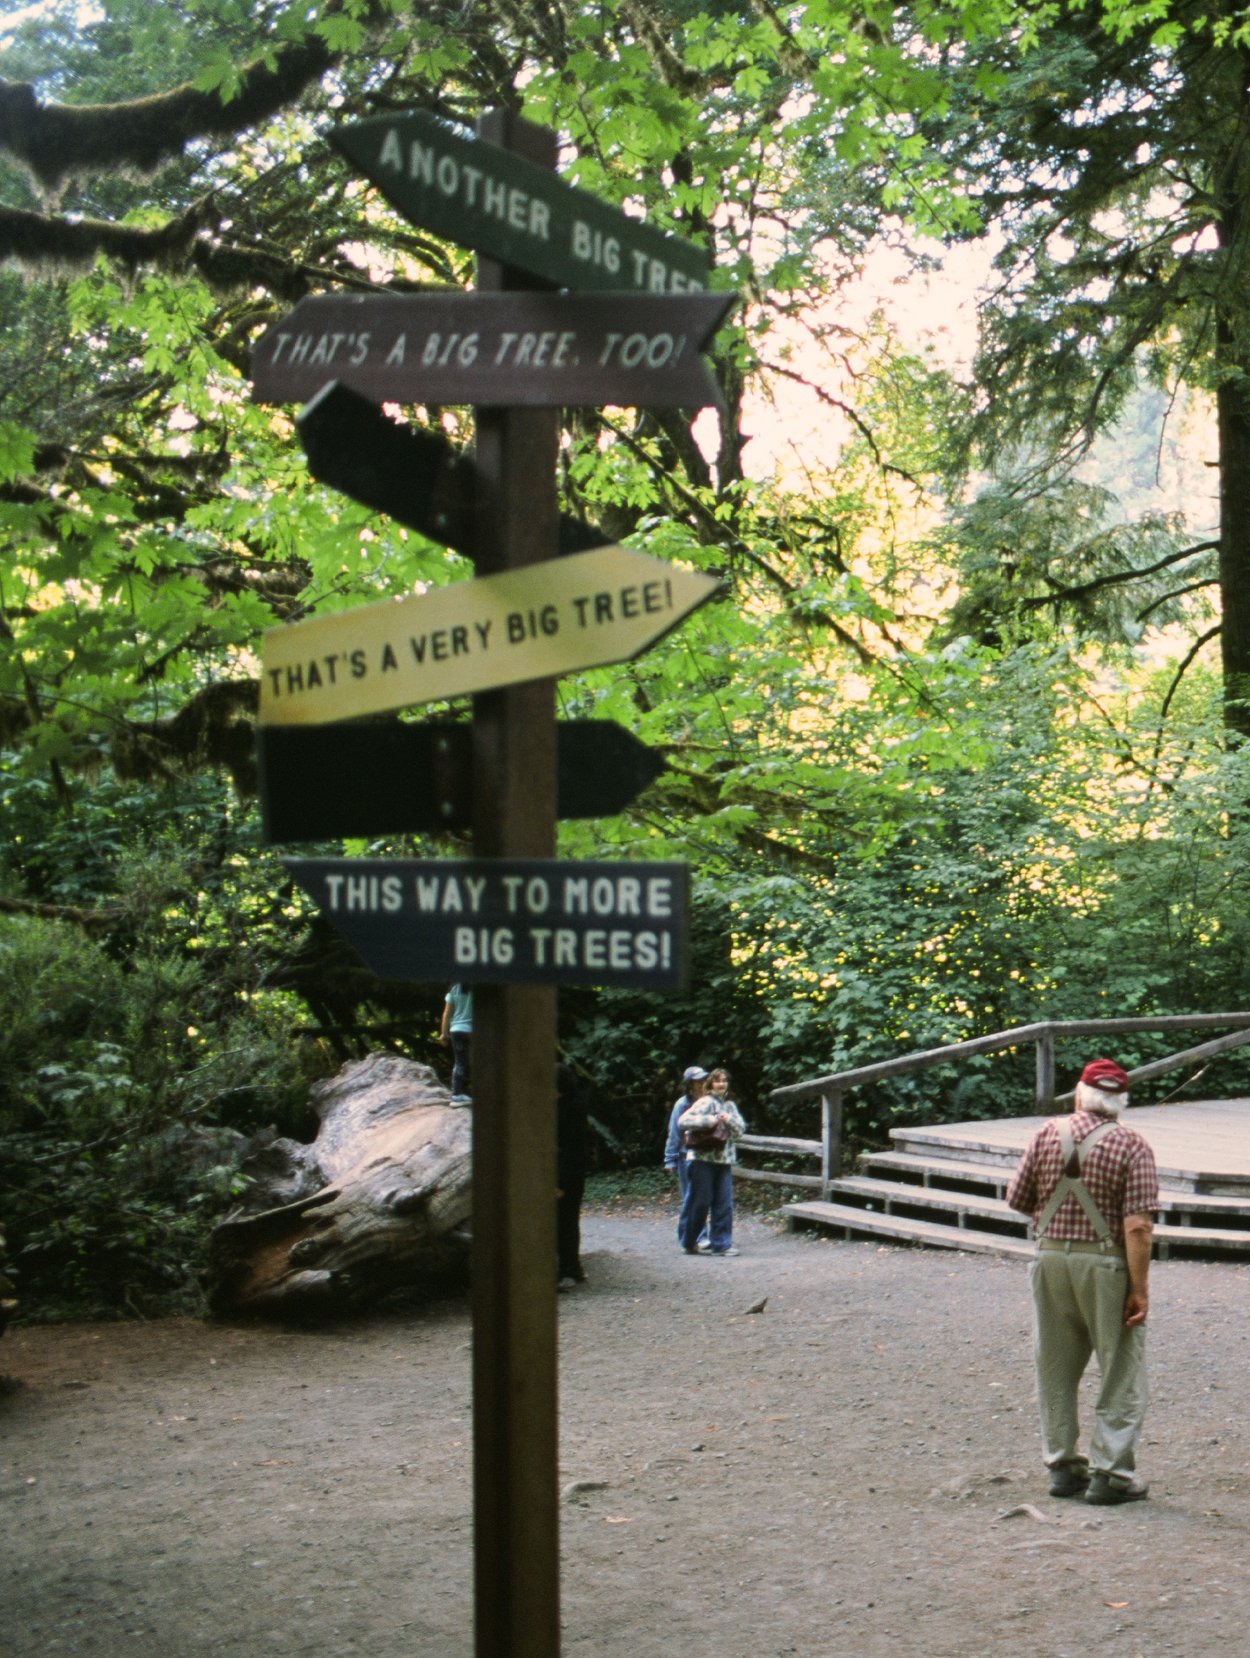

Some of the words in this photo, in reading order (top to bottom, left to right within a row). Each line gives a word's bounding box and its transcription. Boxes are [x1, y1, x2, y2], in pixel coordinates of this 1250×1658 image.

[379, 128, 550, 241] ANOTHER
[572, 219, 621, 274] BIG
[270, 332, 372, 367] THAT'S
[385, 332, 407, 367] A
[421, 332, 480, 368] BIG
[598, 332, 688, 369] TOO!
[267, 648, 368, 698] THAT'S
[381, 641, 399, 672] A
[410, 619, 493, 664] VERY
[506, 603, 560, 645] BIG
[572, 576, 673, 629] TREE!
[325, 874, 403, 912] THIS
[416, 875, 487, 913] WAY
[502, 876, 549, 914] TO
[564, 876, 672, 917] MORE
[455, 926, 514, 965] BIG
[529, 928, 672, 970] TREES!
